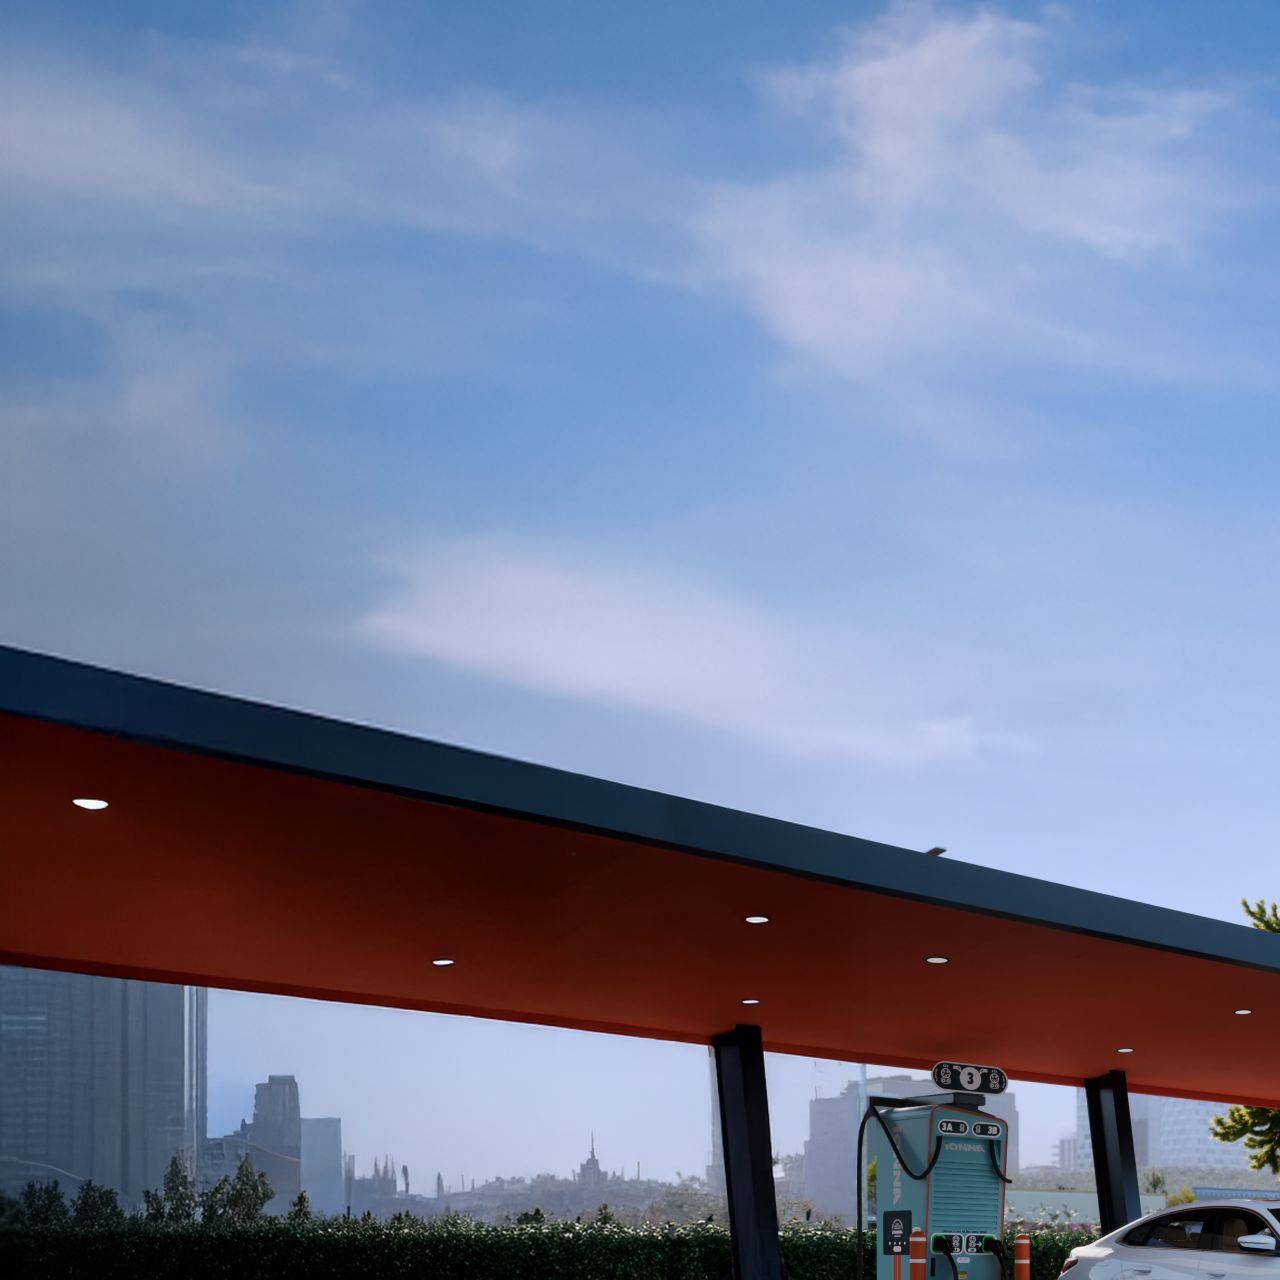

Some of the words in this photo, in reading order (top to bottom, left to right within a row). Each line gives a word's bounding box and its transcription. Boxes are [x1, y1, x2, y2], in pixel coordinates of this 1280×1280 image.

[966, 1072, 974, 1085] 3
[941, 1122, 953, 1131] 3A
[987, 1126, 998, 1135] 3B
